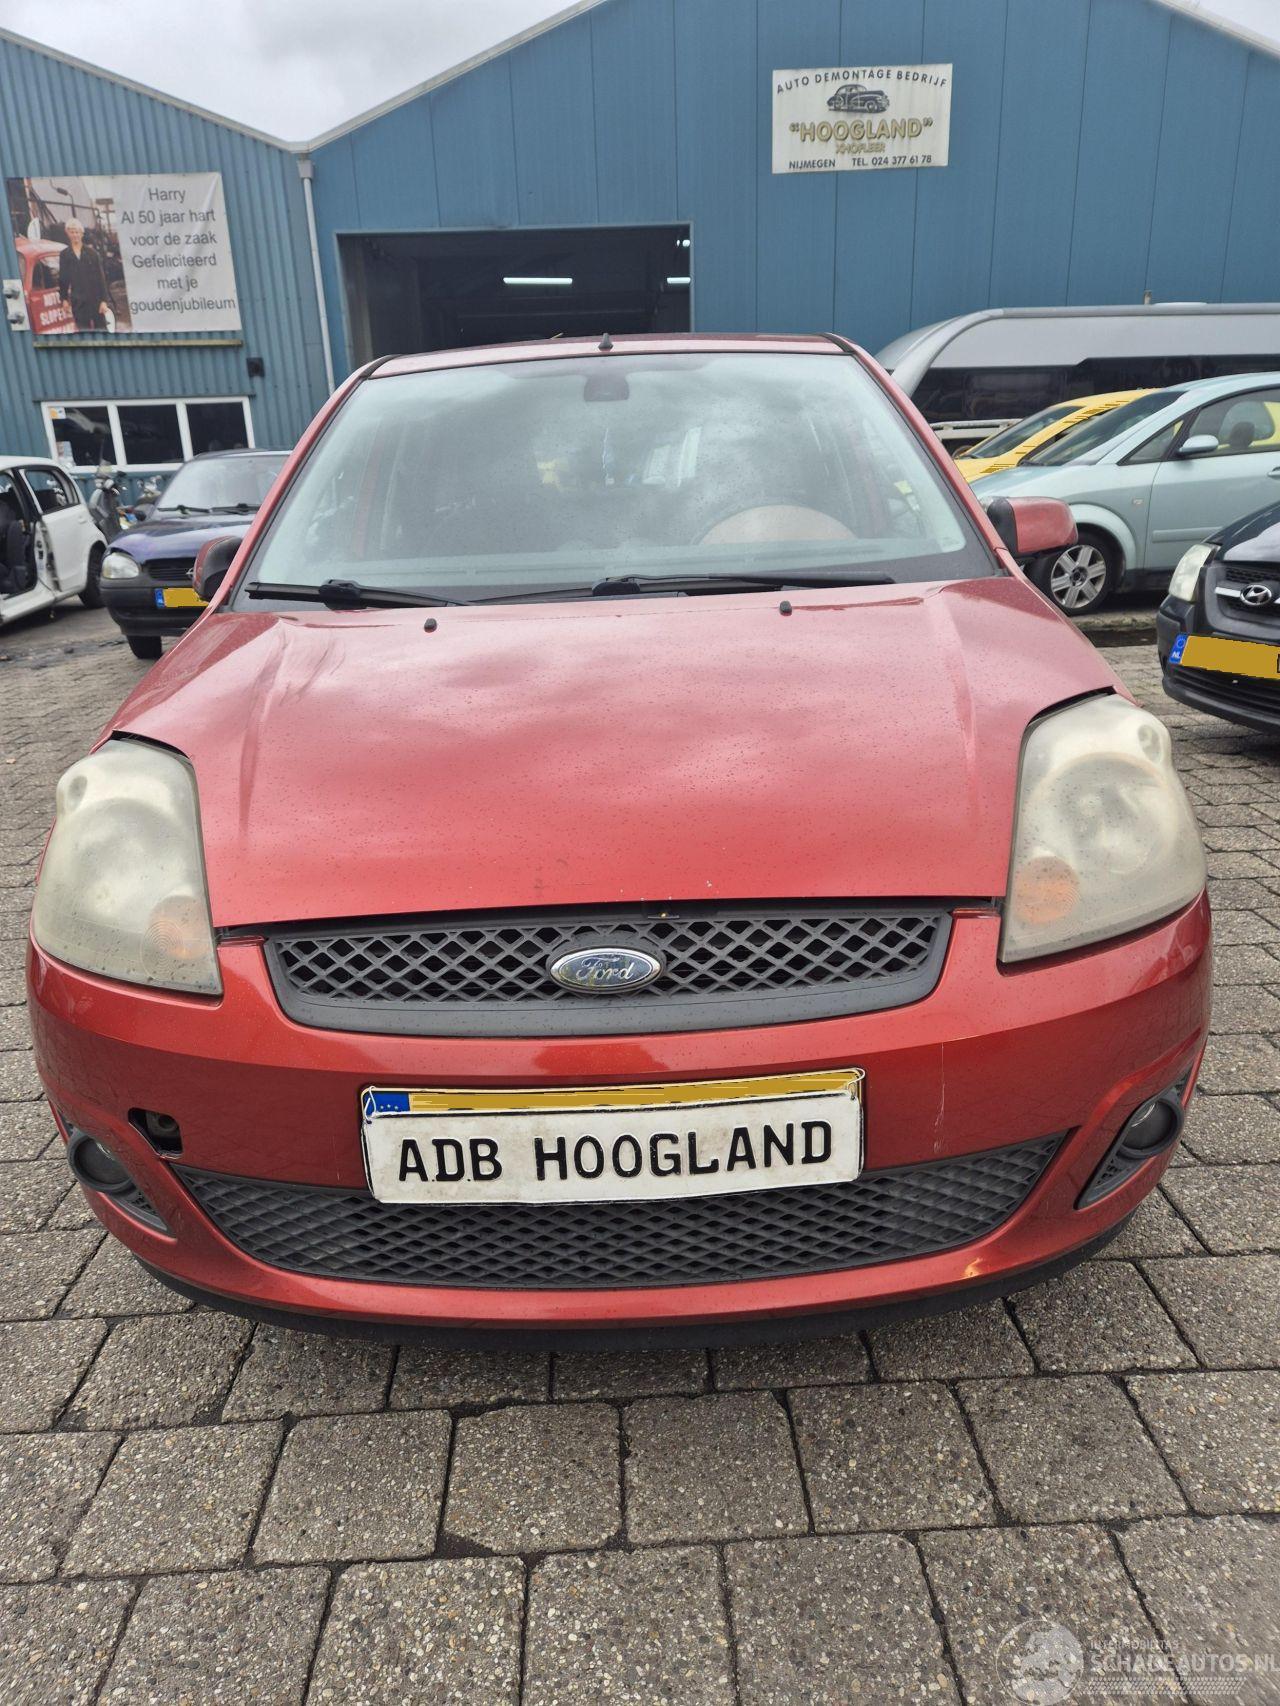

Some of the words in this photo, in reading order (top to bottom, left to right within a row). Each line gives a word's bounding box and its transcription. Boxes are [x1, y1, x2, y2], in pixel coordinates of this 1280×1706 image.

[777, 76, 809, 94] AUTO
[815, 69, 891, 84] DEMONTAGE
[897, 70, 947, 87] BEDRIJF
[789, 159, 836, 169] NIJMEGEN
[852, 157, 868, 167] TEL.
[871, 156, 889, 166] 024
[892, 155, 907, 165] 377
[909, 155, 919, 164] 61
[921, 154, 932, 164] 78
[148, 187, 186, 204] Harry
[121, 211, 135, 224] Al
[138, 210, 156, 224] 50
[159, 209, 186, 227] jaar
[189, 208, 216, 223] hart
[129, 234, 160, 246] voor
[163, 232, 181, 246] de
[184, 230, 218, 245] zaak
[132, 252, 217, 268] Gefeliciteerd
[157, 277, 183, 289] met
[185, 275, 198, 292] je
[130, 297, 236, 315] goudenjubileum
[575, 956, 636, 982] Ford
[534, 1119, 833, 1182] HOOGLAND
